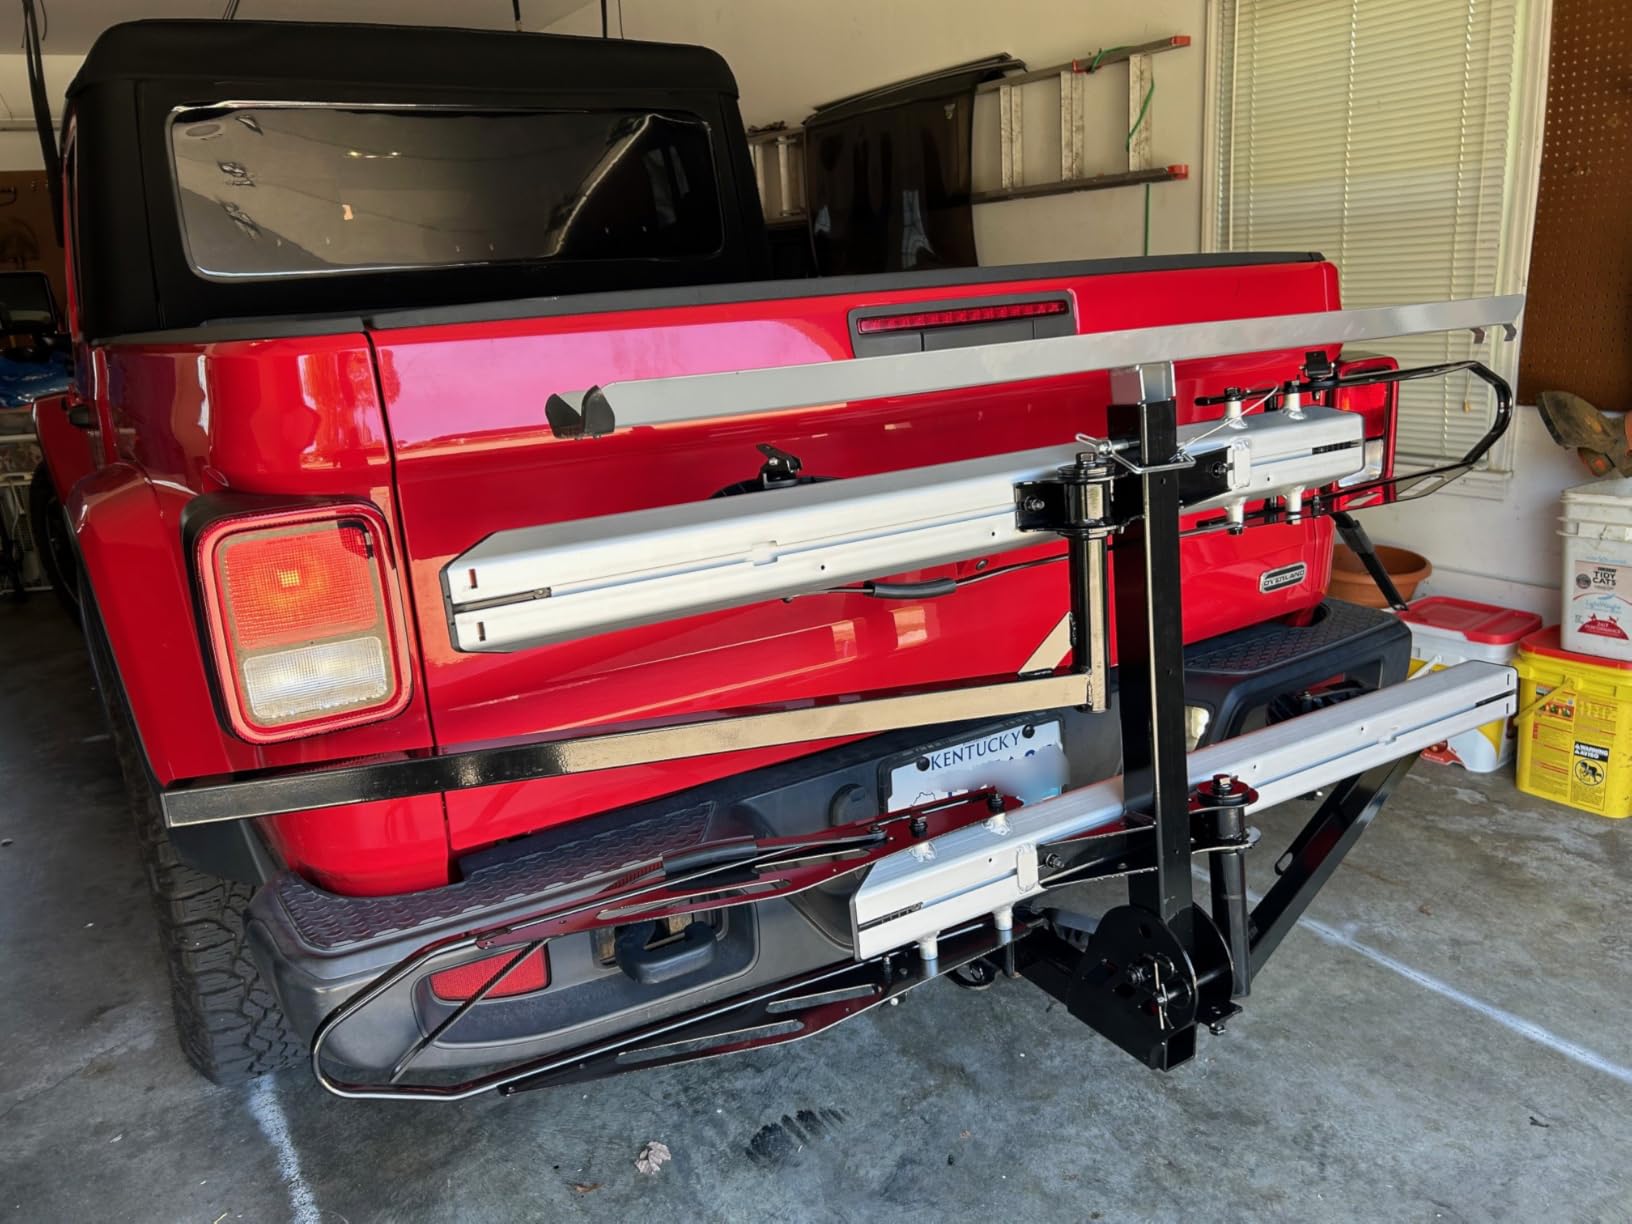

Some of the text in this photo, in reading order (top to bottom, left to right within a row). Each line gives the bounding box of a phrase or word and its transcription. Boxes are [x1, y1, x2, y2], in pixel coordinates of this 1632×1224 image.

[1264, 570, 1304, 586] OVERLAND
[1593, 571, 1615, 579] TIDY
[1592, 578, 1616, 586] CATS
[931, 730, 1021, 771] KENTUCKY
[1580, 744, 1608, 756] WARNING
